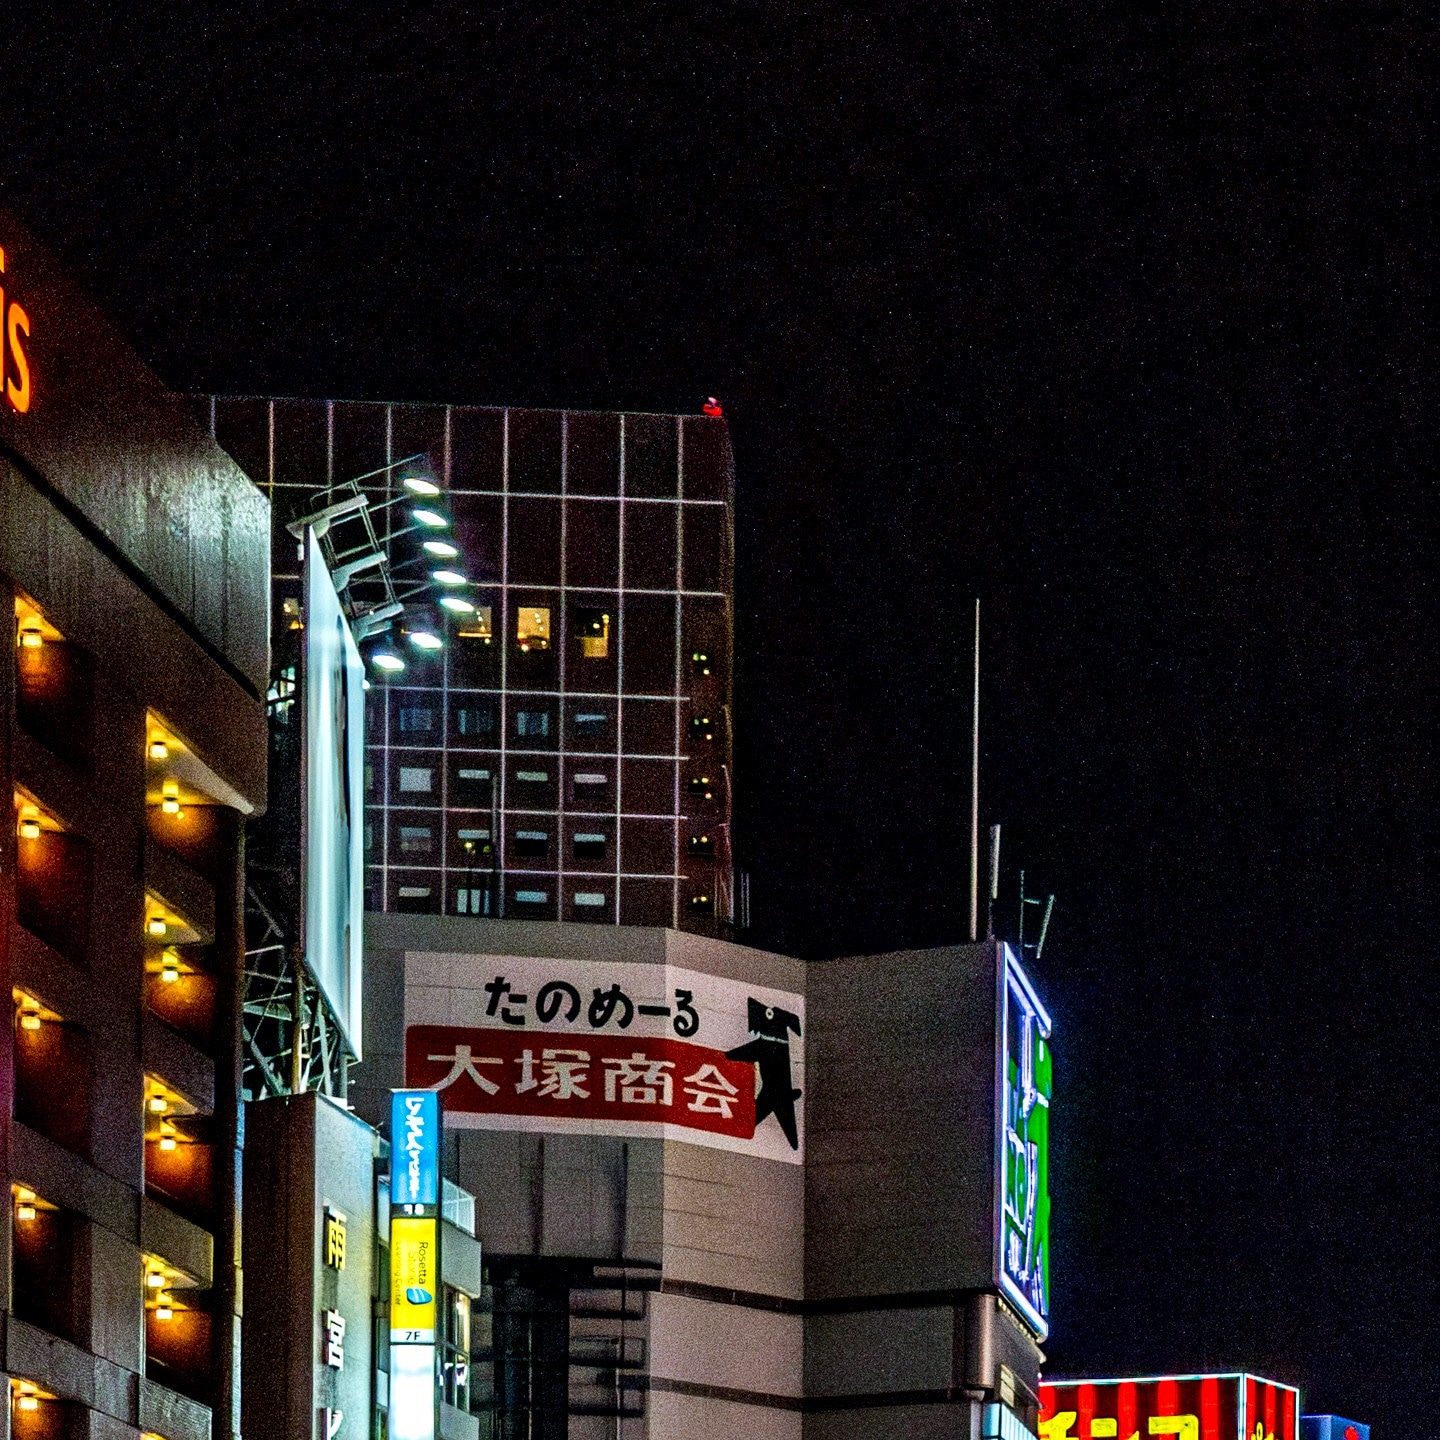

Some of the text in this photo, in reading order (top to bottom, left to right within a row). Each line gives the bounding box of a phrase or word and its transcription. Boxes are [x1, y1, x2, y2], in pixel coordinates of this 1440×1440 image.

[483, 974, 700, 1037] たのめーる
[425, 1047, 741, 1121] 大塚商会
[407, 1250, 417, 1285] Stone
[418, 1242, 429, 1285] Rosetta
[394, 1279, 402, 1306] Center
[405, 1331, 421, 1341] 7F
